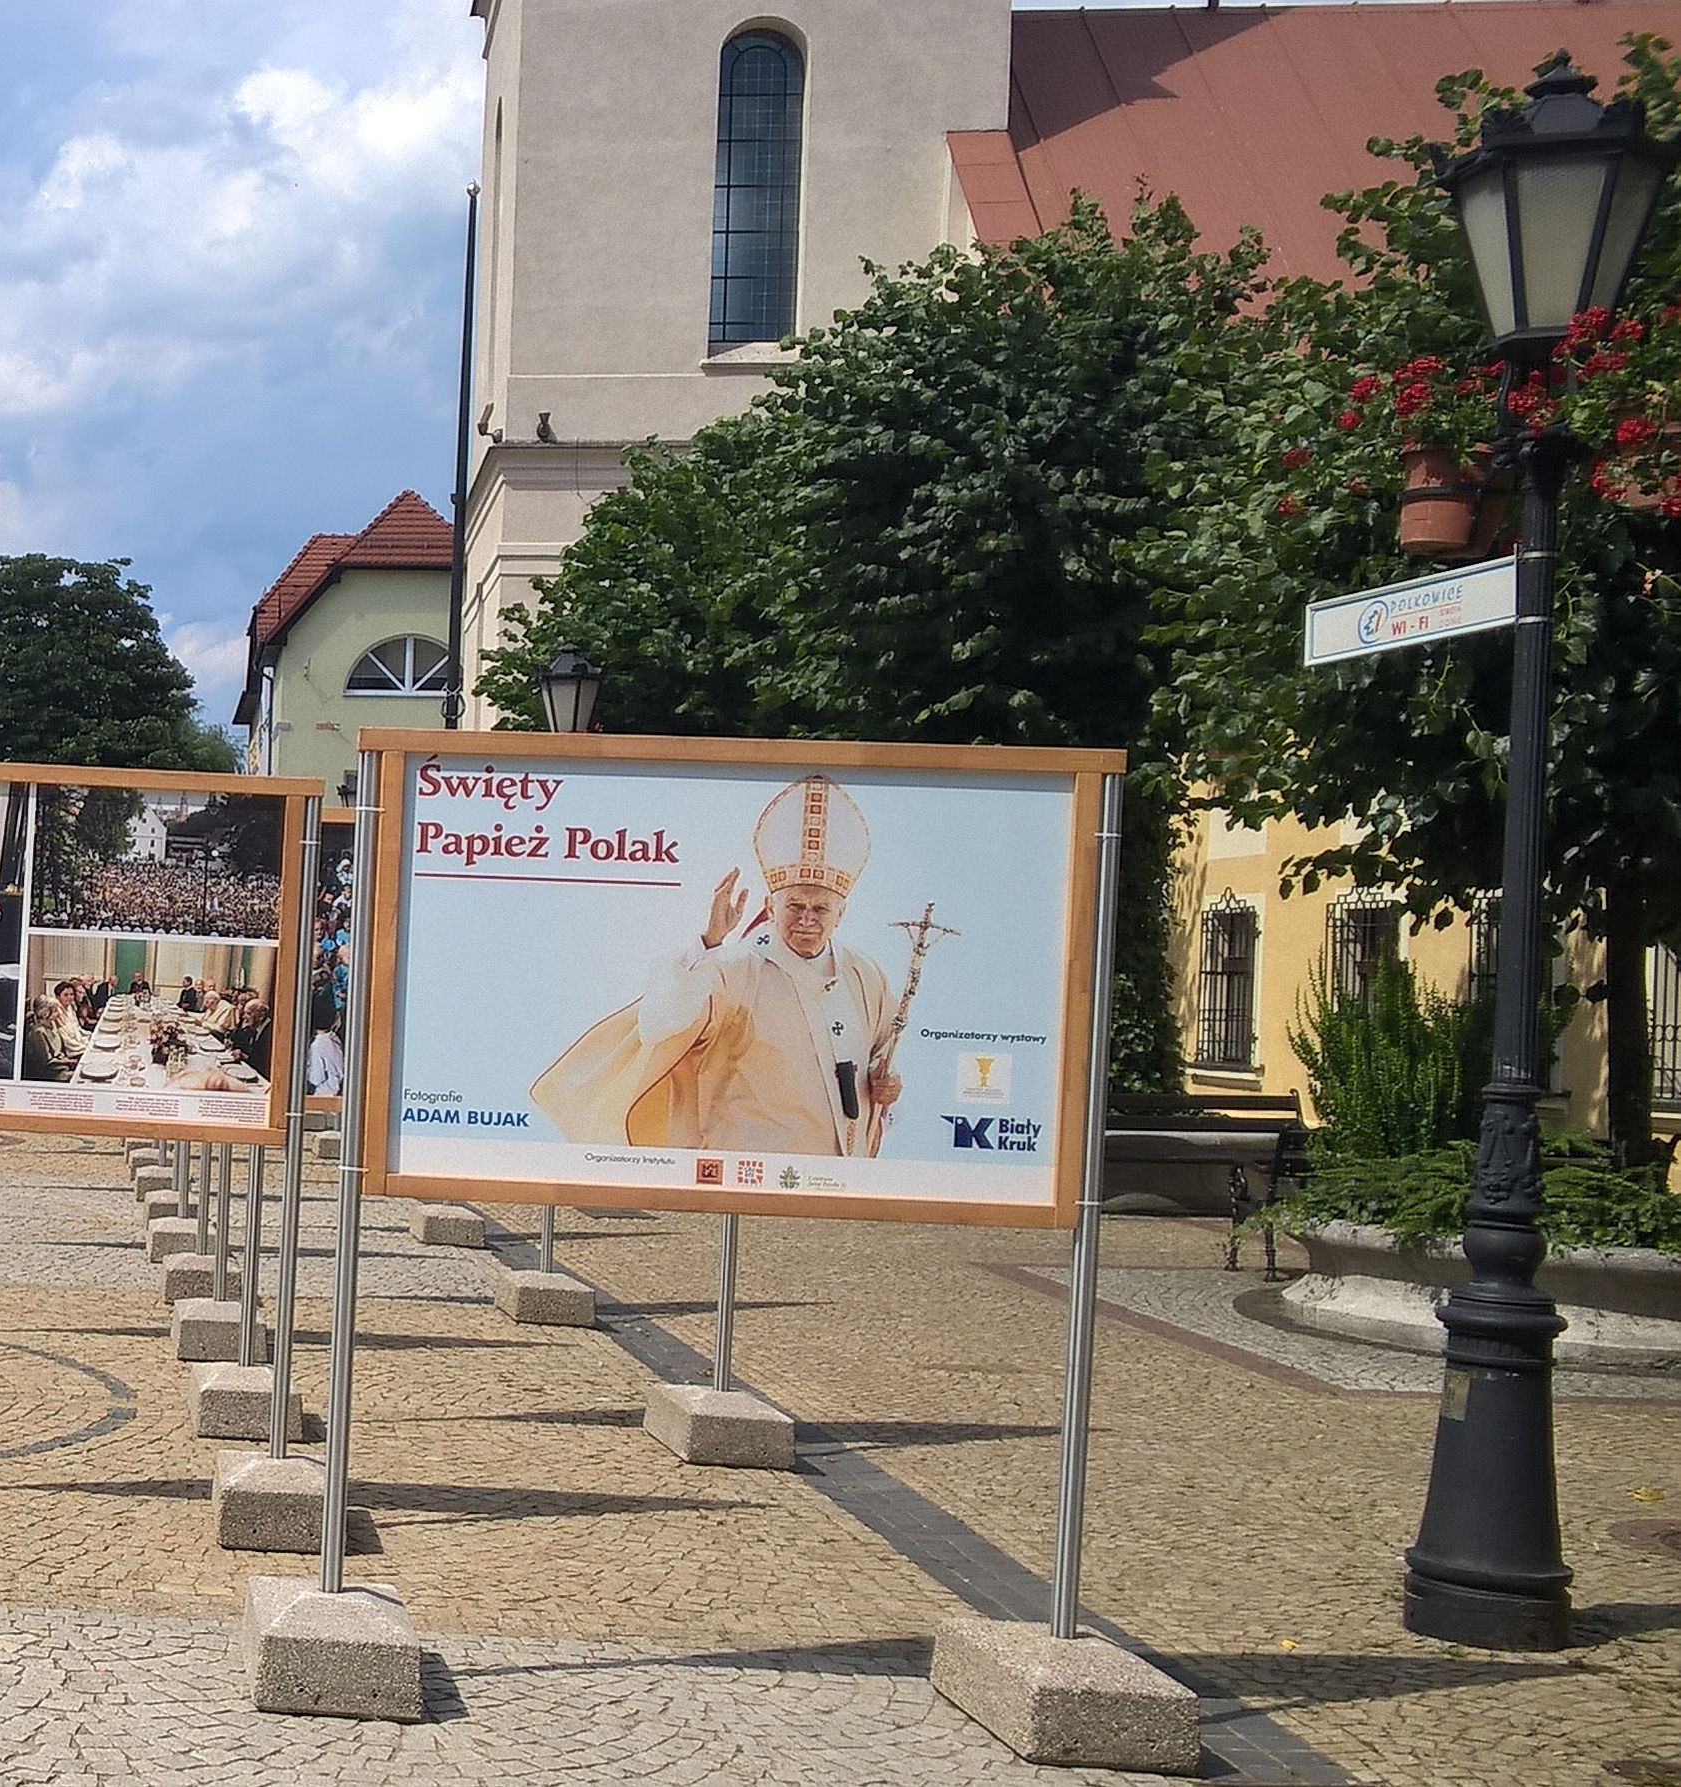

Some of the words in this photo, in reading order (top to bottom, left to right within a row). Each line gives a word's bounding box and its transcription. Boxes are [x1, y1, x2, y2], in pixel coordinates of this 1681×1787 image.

[1390, 585, 1463, 612] POLKOWICE
[418, 753, 564, 811] Święty
[416, 822, 550, 867] Papież
[563, 827, 680, 864] Polak
[920, 1028, 998, 1043] Organizatorzy
[1001, 1033, 1047, 1045] wystawy
[404, 1088, 463, 1105] Fotografie
[402, 1107, 461, 1125] ADAM
[468, 1110, 530, 1128] BUJAK
[998, 1117, 1042, 1138] Biały
[997, 1136, 1037, 1152] Kruk
[584, 1152, 640, 1165] Organizatorzy
